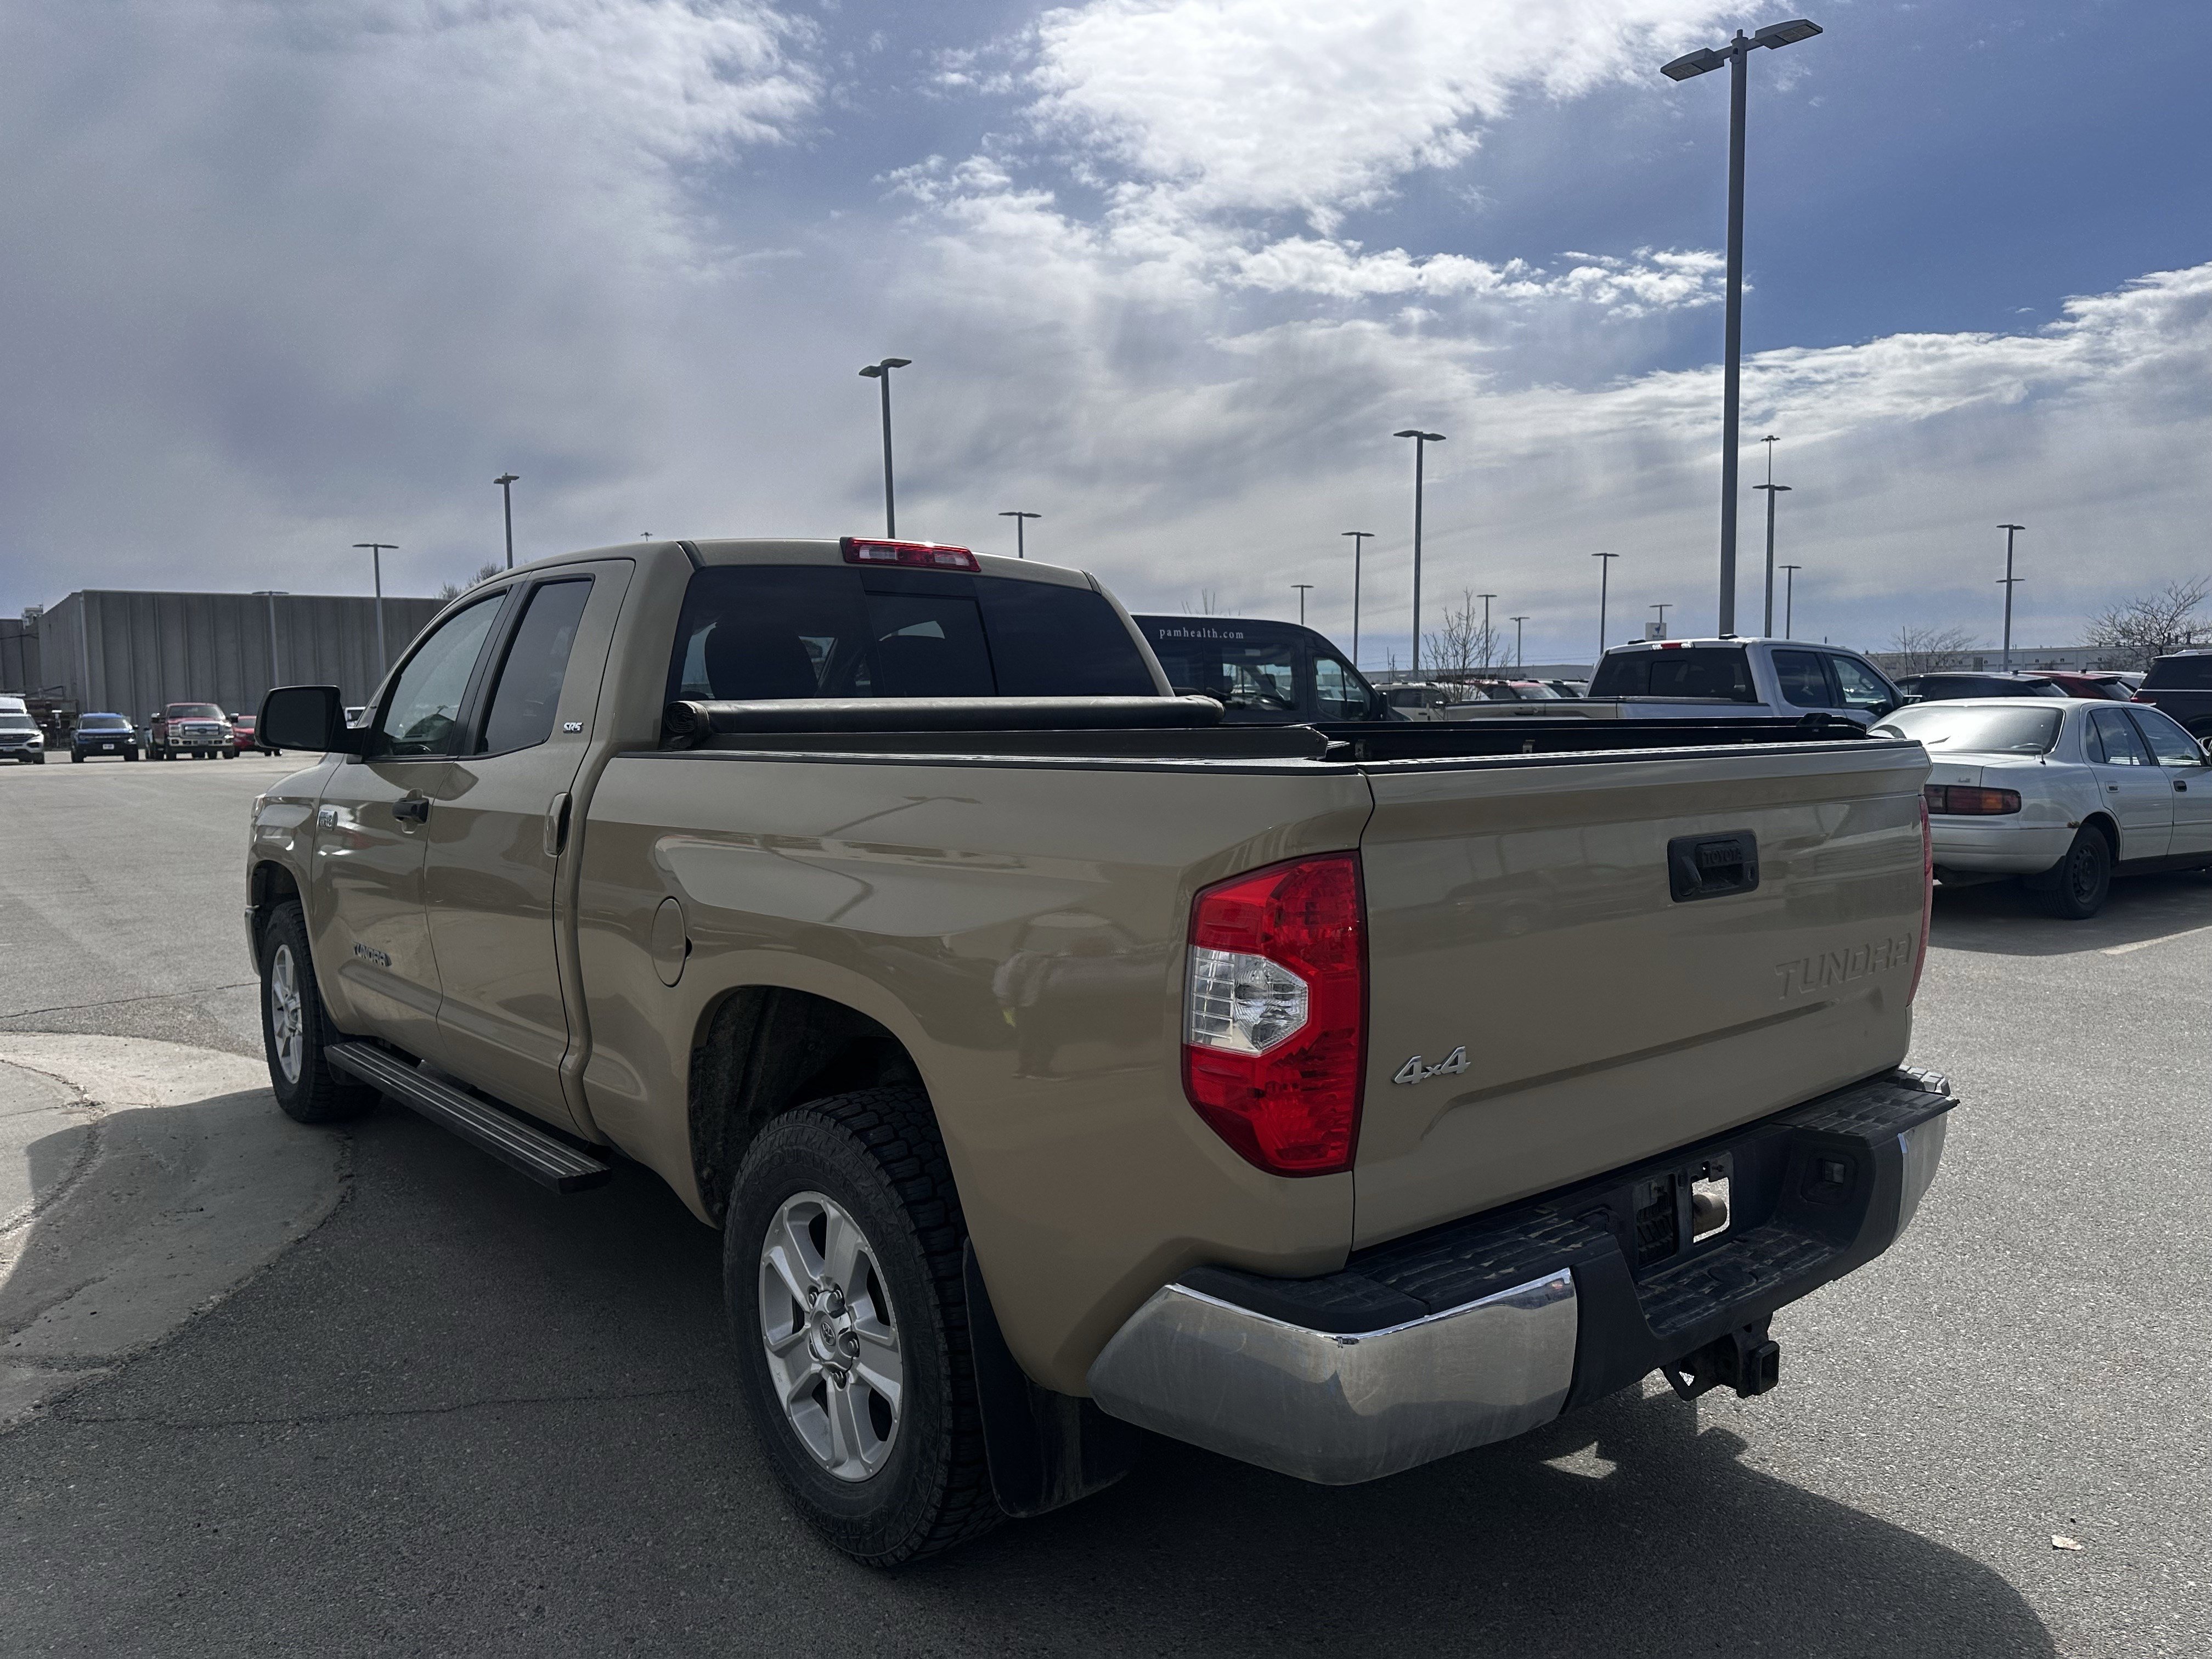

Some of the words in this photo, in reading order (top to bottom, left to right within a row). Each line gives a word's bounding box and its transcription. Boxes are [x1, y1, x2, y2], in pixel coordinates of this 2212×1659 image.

[1159, 627, 1244, 639] pamhealth.com
[563, 722, 583, 732] SR5
[1703, 848, 1742, 864] TOYOTA
[1775, 933, 1912, 1000] TUNDRA
[1391, 1046, 1471, 1085] 4x4
